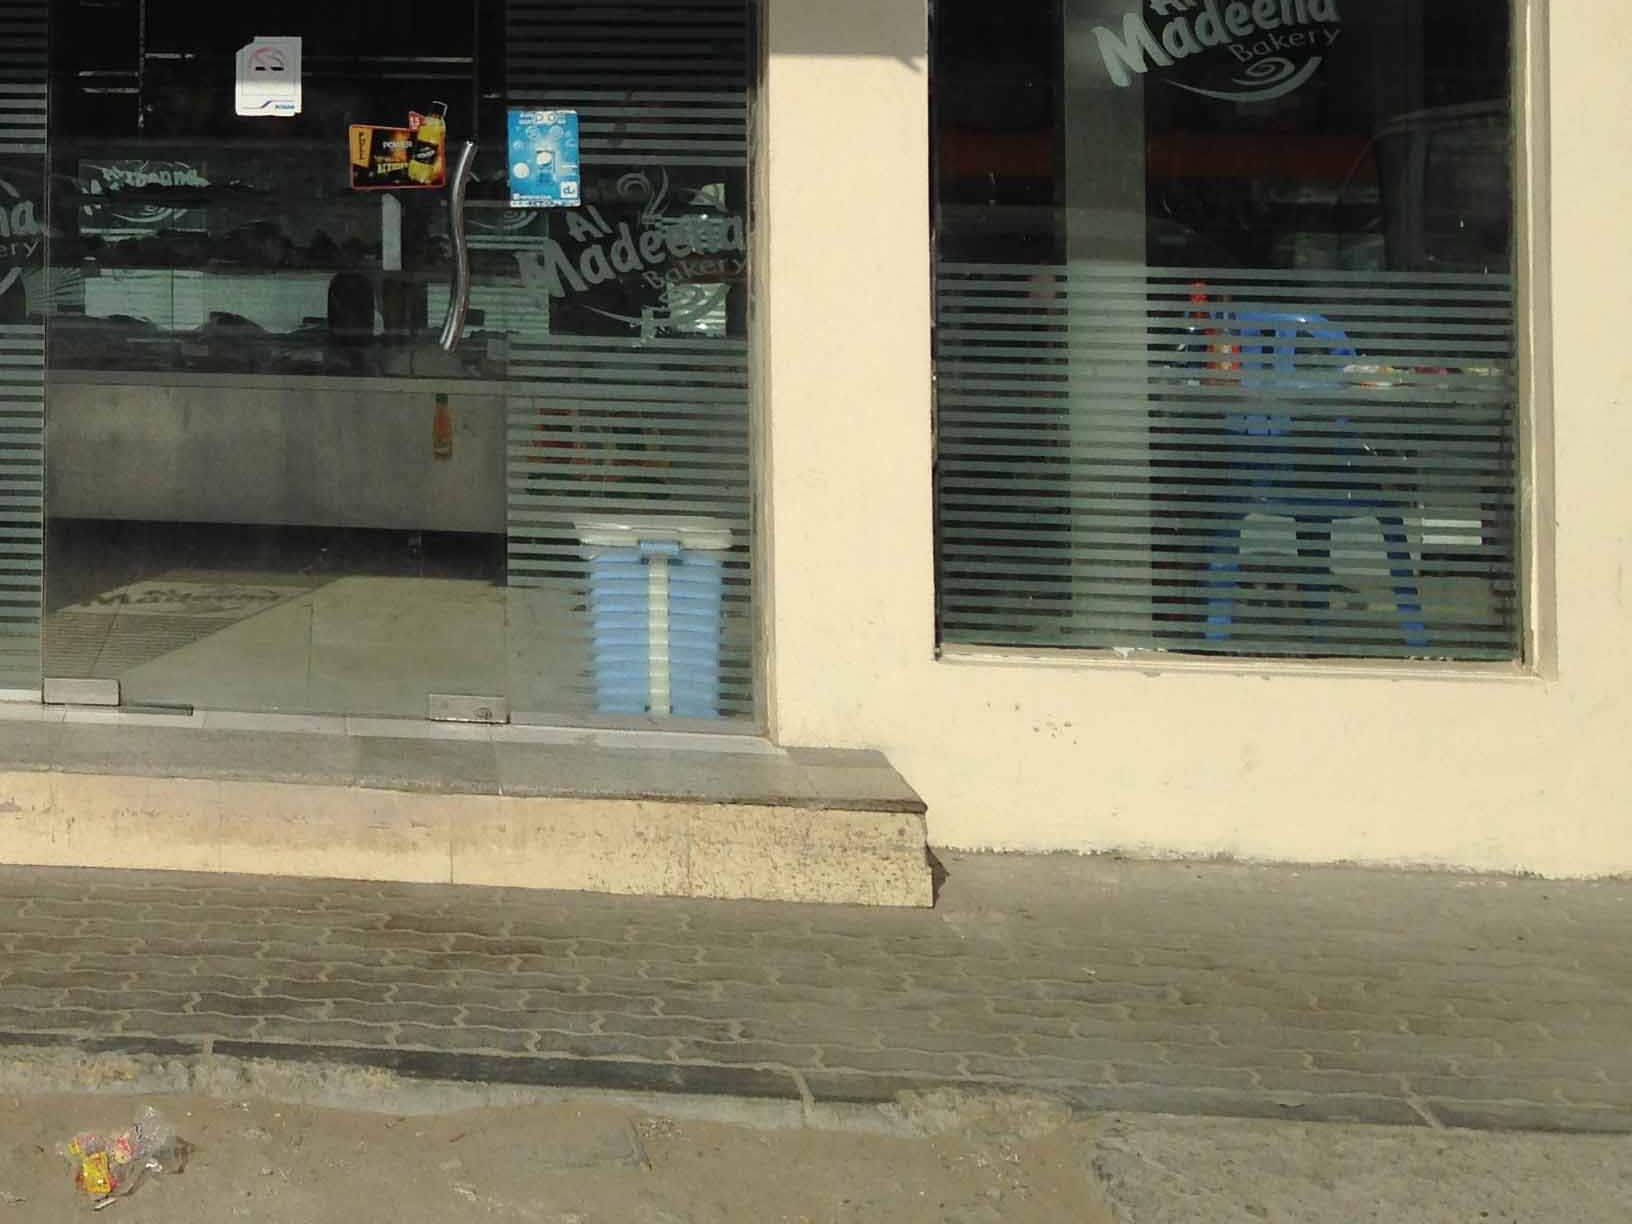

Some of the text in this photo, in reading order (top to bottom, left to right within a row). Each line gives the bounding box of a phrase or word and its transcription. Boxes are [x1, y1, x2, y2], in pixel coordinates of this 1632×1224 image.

[1228, 25, 1342, 65] Bakery
[564, 204, 614, 244] Al
[514, 216, 744, 298] Madeena
